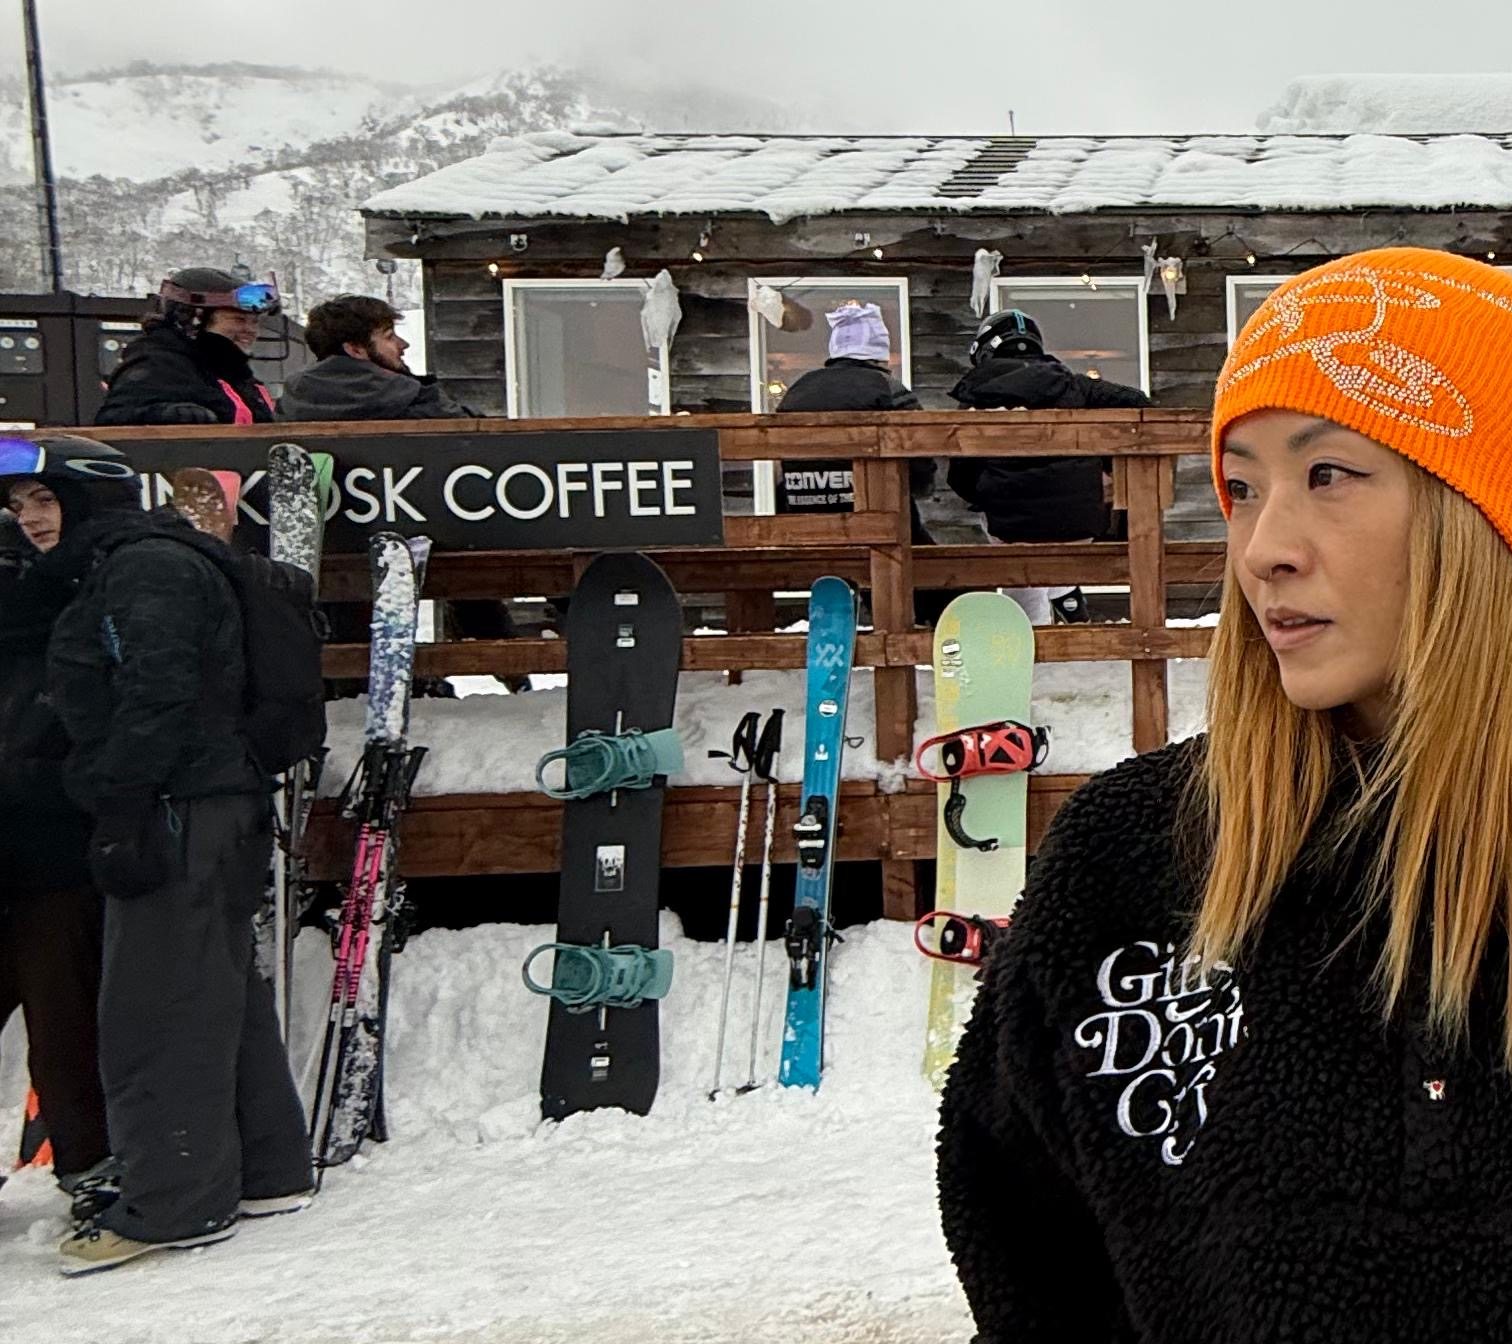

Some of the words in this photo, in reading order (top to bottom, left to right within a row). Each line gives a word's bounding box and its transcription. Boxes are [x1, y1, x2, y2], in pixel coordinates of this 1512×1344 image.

[236, 466, 428, 525] KSK
[443, 459, 697, 521] COFFEE
[784, 470, 854, 490] CONVER
